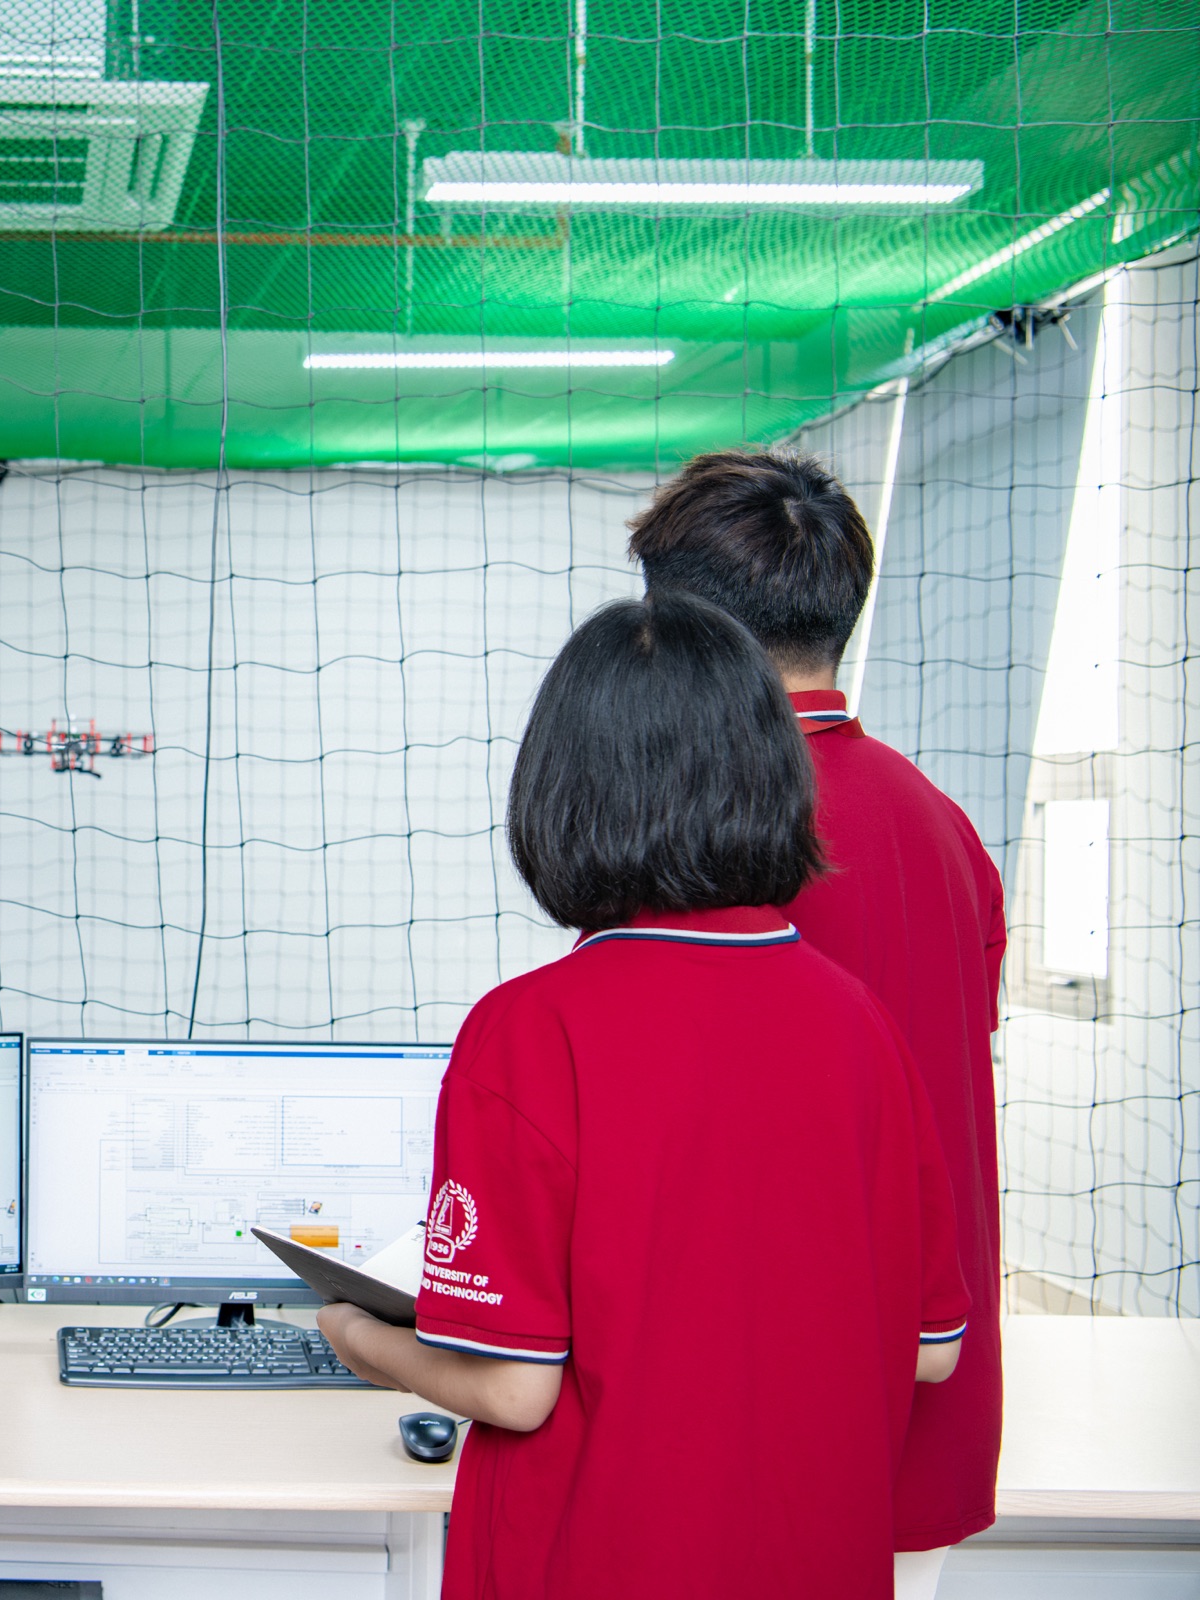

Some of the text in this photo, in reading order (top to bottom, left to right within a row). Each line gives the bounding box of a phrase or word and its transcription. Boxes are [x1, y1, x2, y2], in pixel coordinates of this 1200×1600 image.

[473, 1274, 489, 1287] OF
[228, 1291, 258, 1300] ASUS
[432, 1280, 503, 1305] TECHNOLOGY
